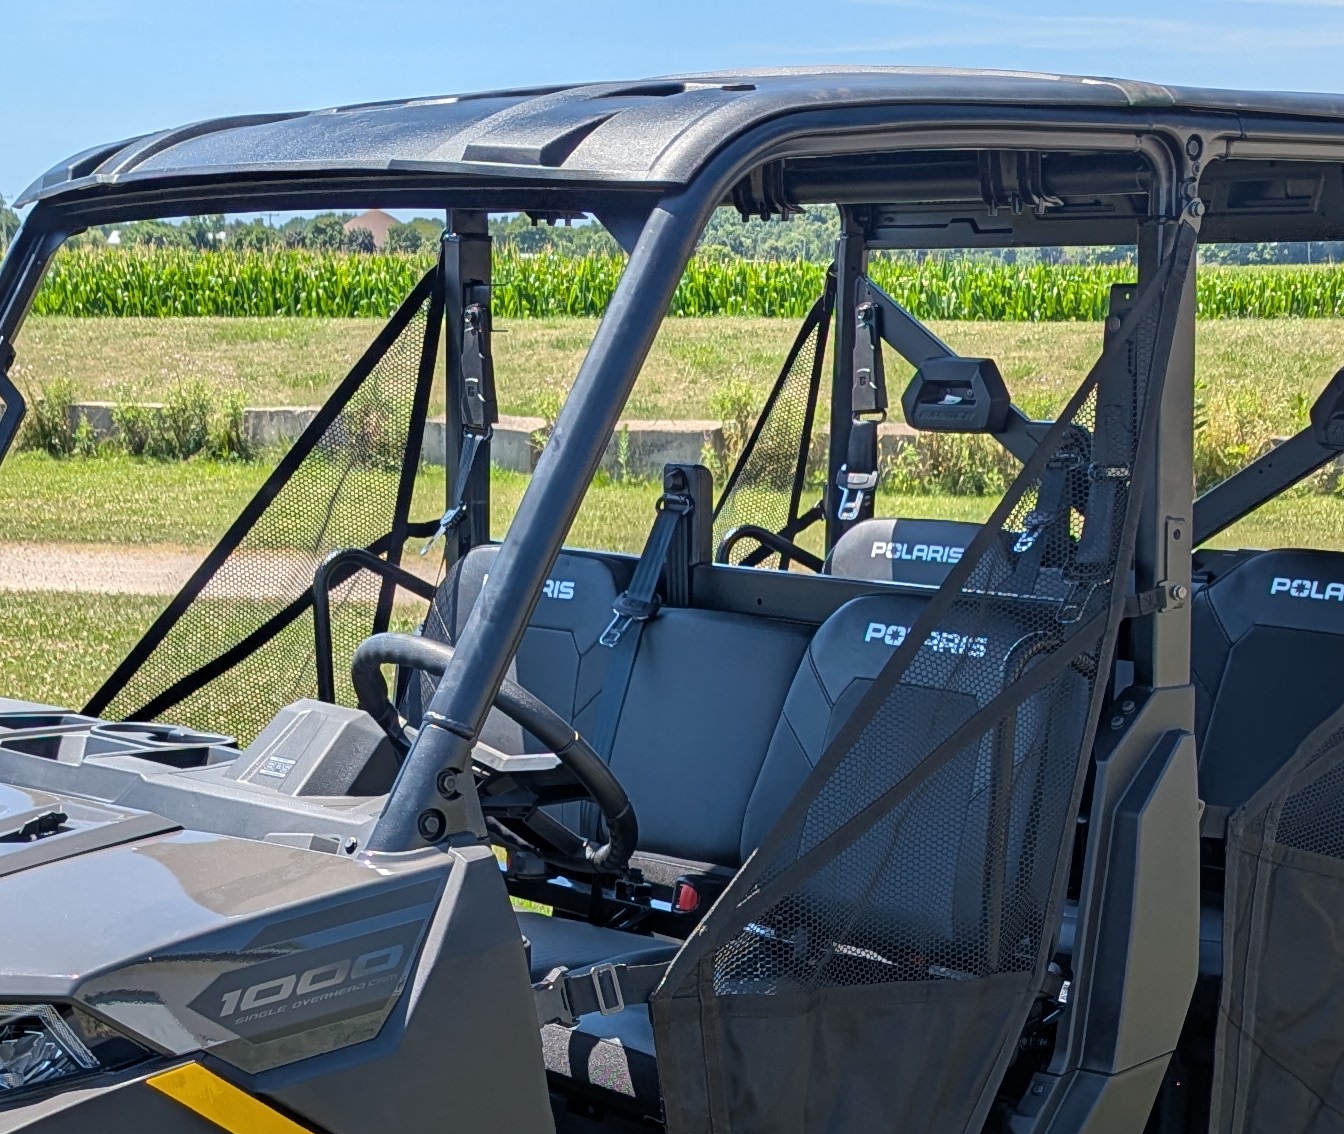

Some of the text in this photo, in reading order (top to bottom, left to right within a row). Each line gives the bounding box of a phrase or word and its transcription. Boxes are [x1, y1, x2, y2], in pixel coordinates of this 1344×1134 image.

[871, 541, 965, 564] POLARIS
[864, 622, 988, 658] POARIS
[219, 943, 404, 1018] 1000
[235, 973, 398, 1025] SINGLE OVERHEAD CAM
